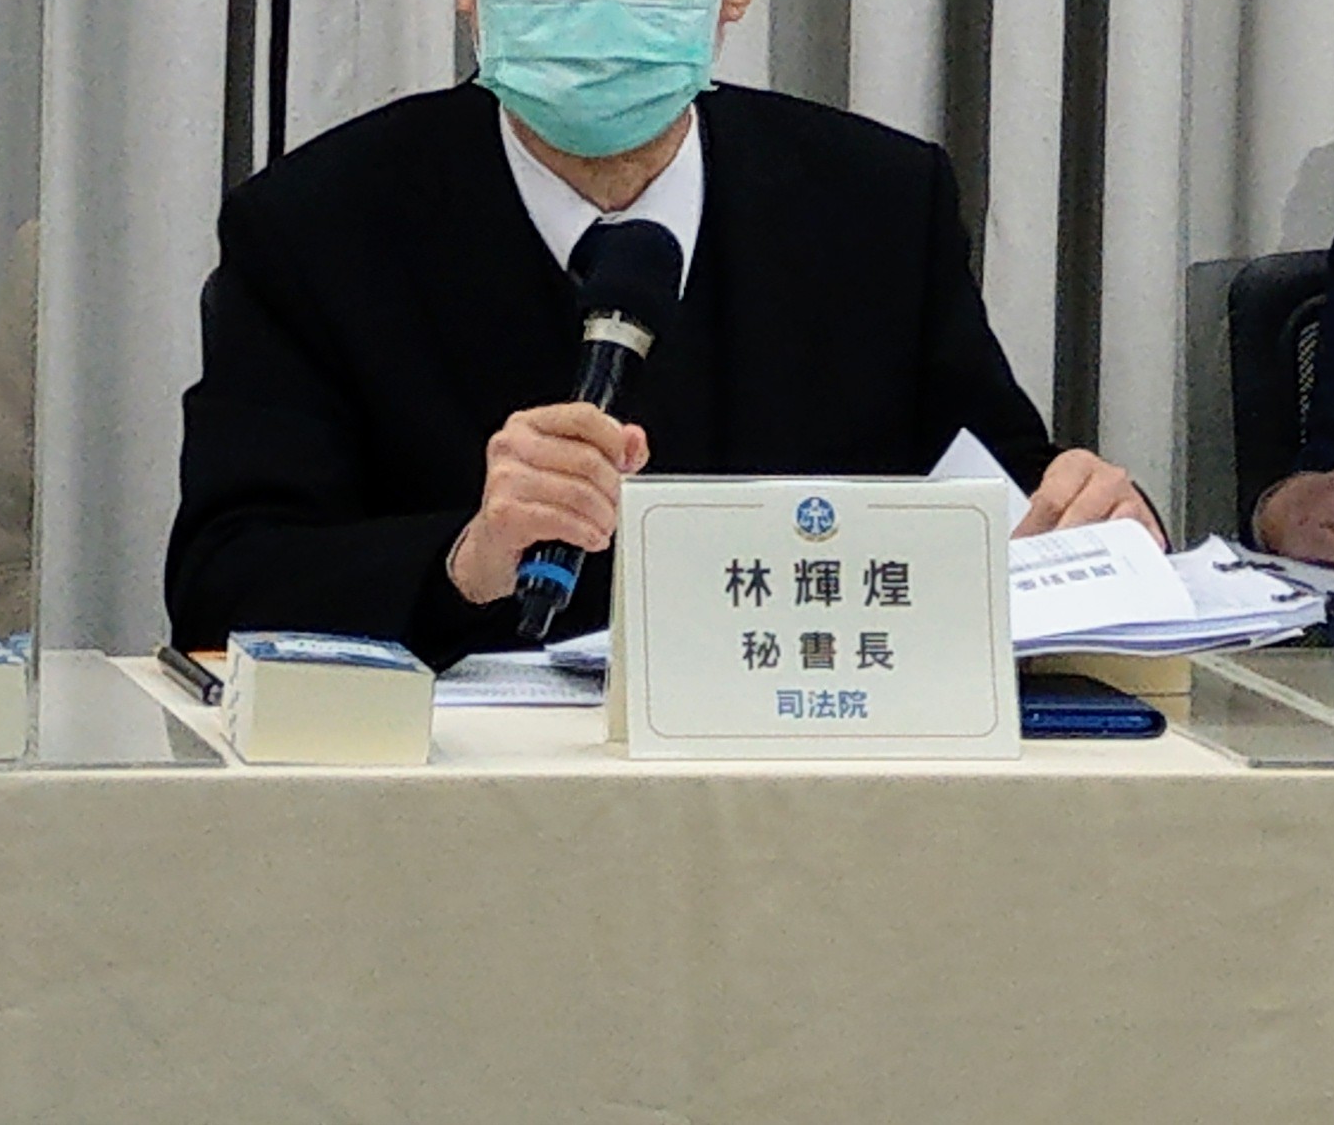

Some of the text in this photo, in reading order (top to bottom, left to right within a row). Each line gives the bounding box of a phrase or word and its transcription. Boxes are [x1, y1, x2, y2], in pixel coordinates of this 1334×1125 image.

[725, 559, 912, 608] 林輝煌
[742, 631, 895, 672] 秘書長
[776, 689, 869, 720] 司法院
